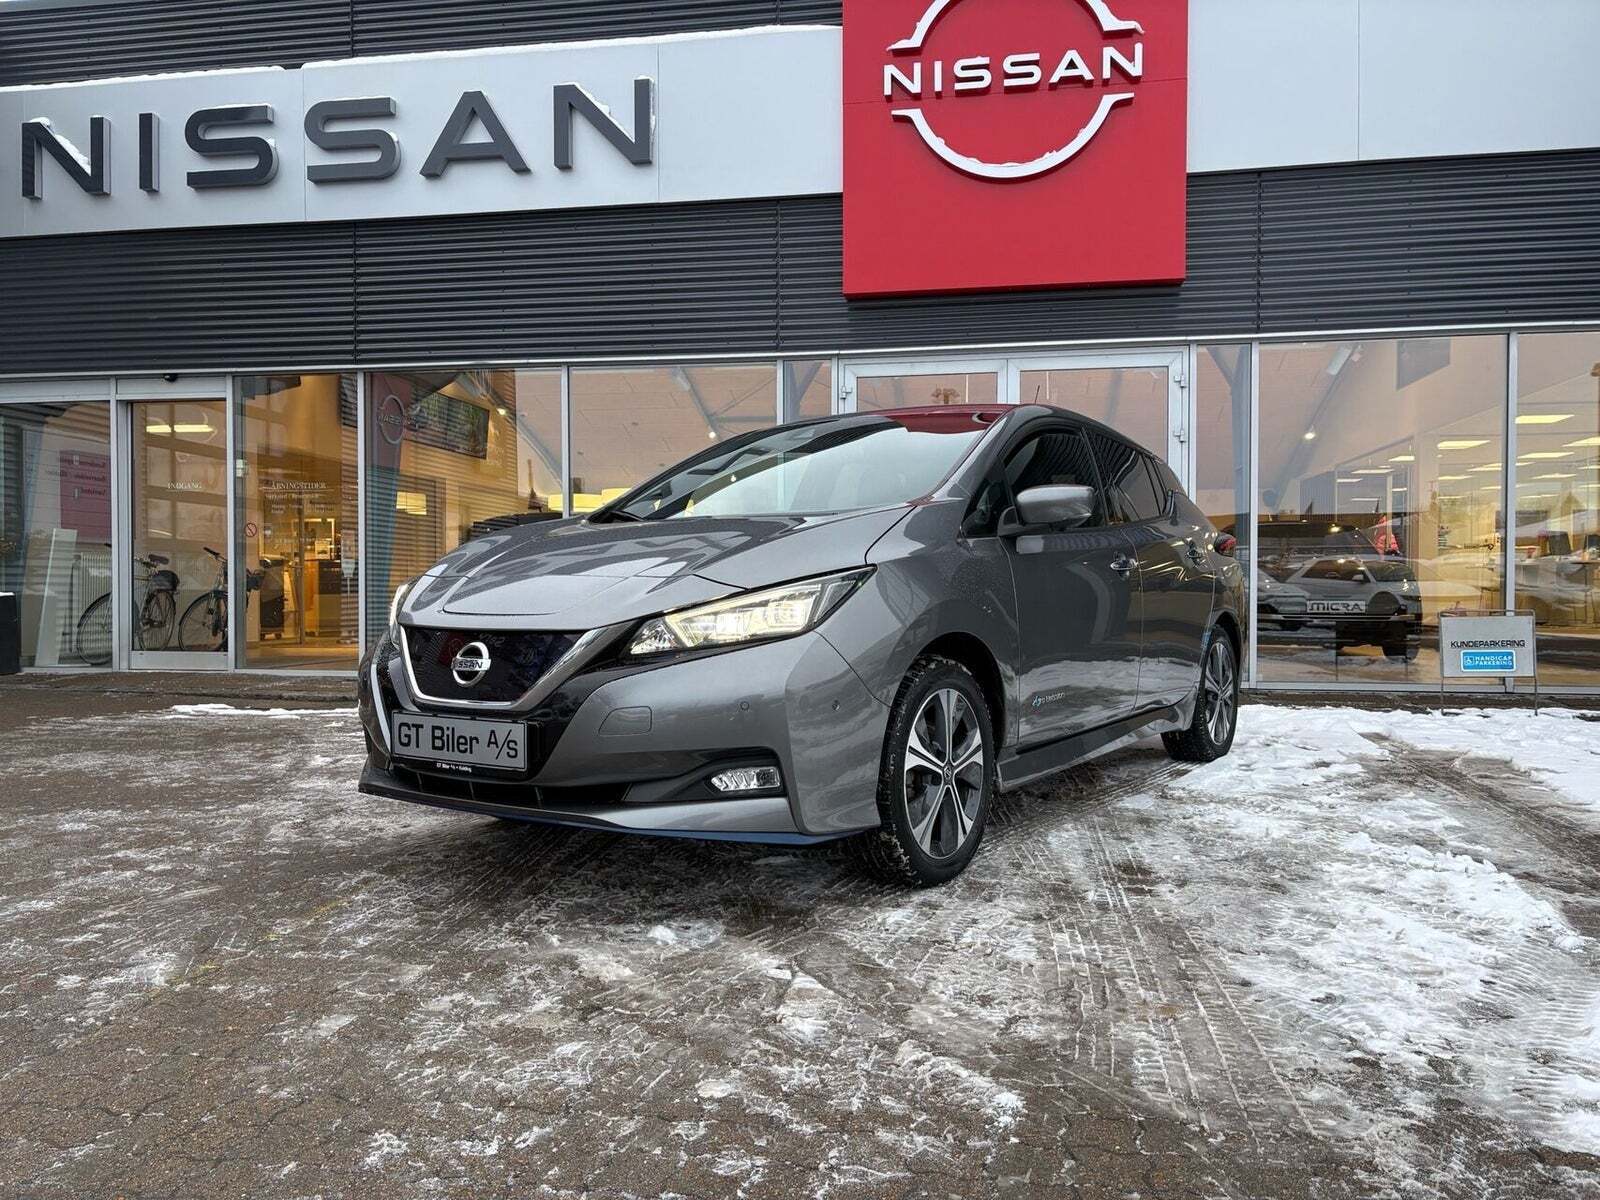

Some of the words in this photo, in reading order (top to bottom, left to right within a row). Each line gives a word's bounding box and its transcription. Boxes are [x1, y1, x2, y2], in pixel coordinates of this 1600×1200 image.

[884, 42, 1144, 97] NISSAN
[21, 76, 654, 201] NISSAN
[1309, 602, 1364, 612] MICRA
[1450, 640, 1526, 648] KUNDEPARKERING
[399, 722, 424, 749] GT
[431, 725, 480, 755] Biler
[487, 729, 519, 760] A/S
